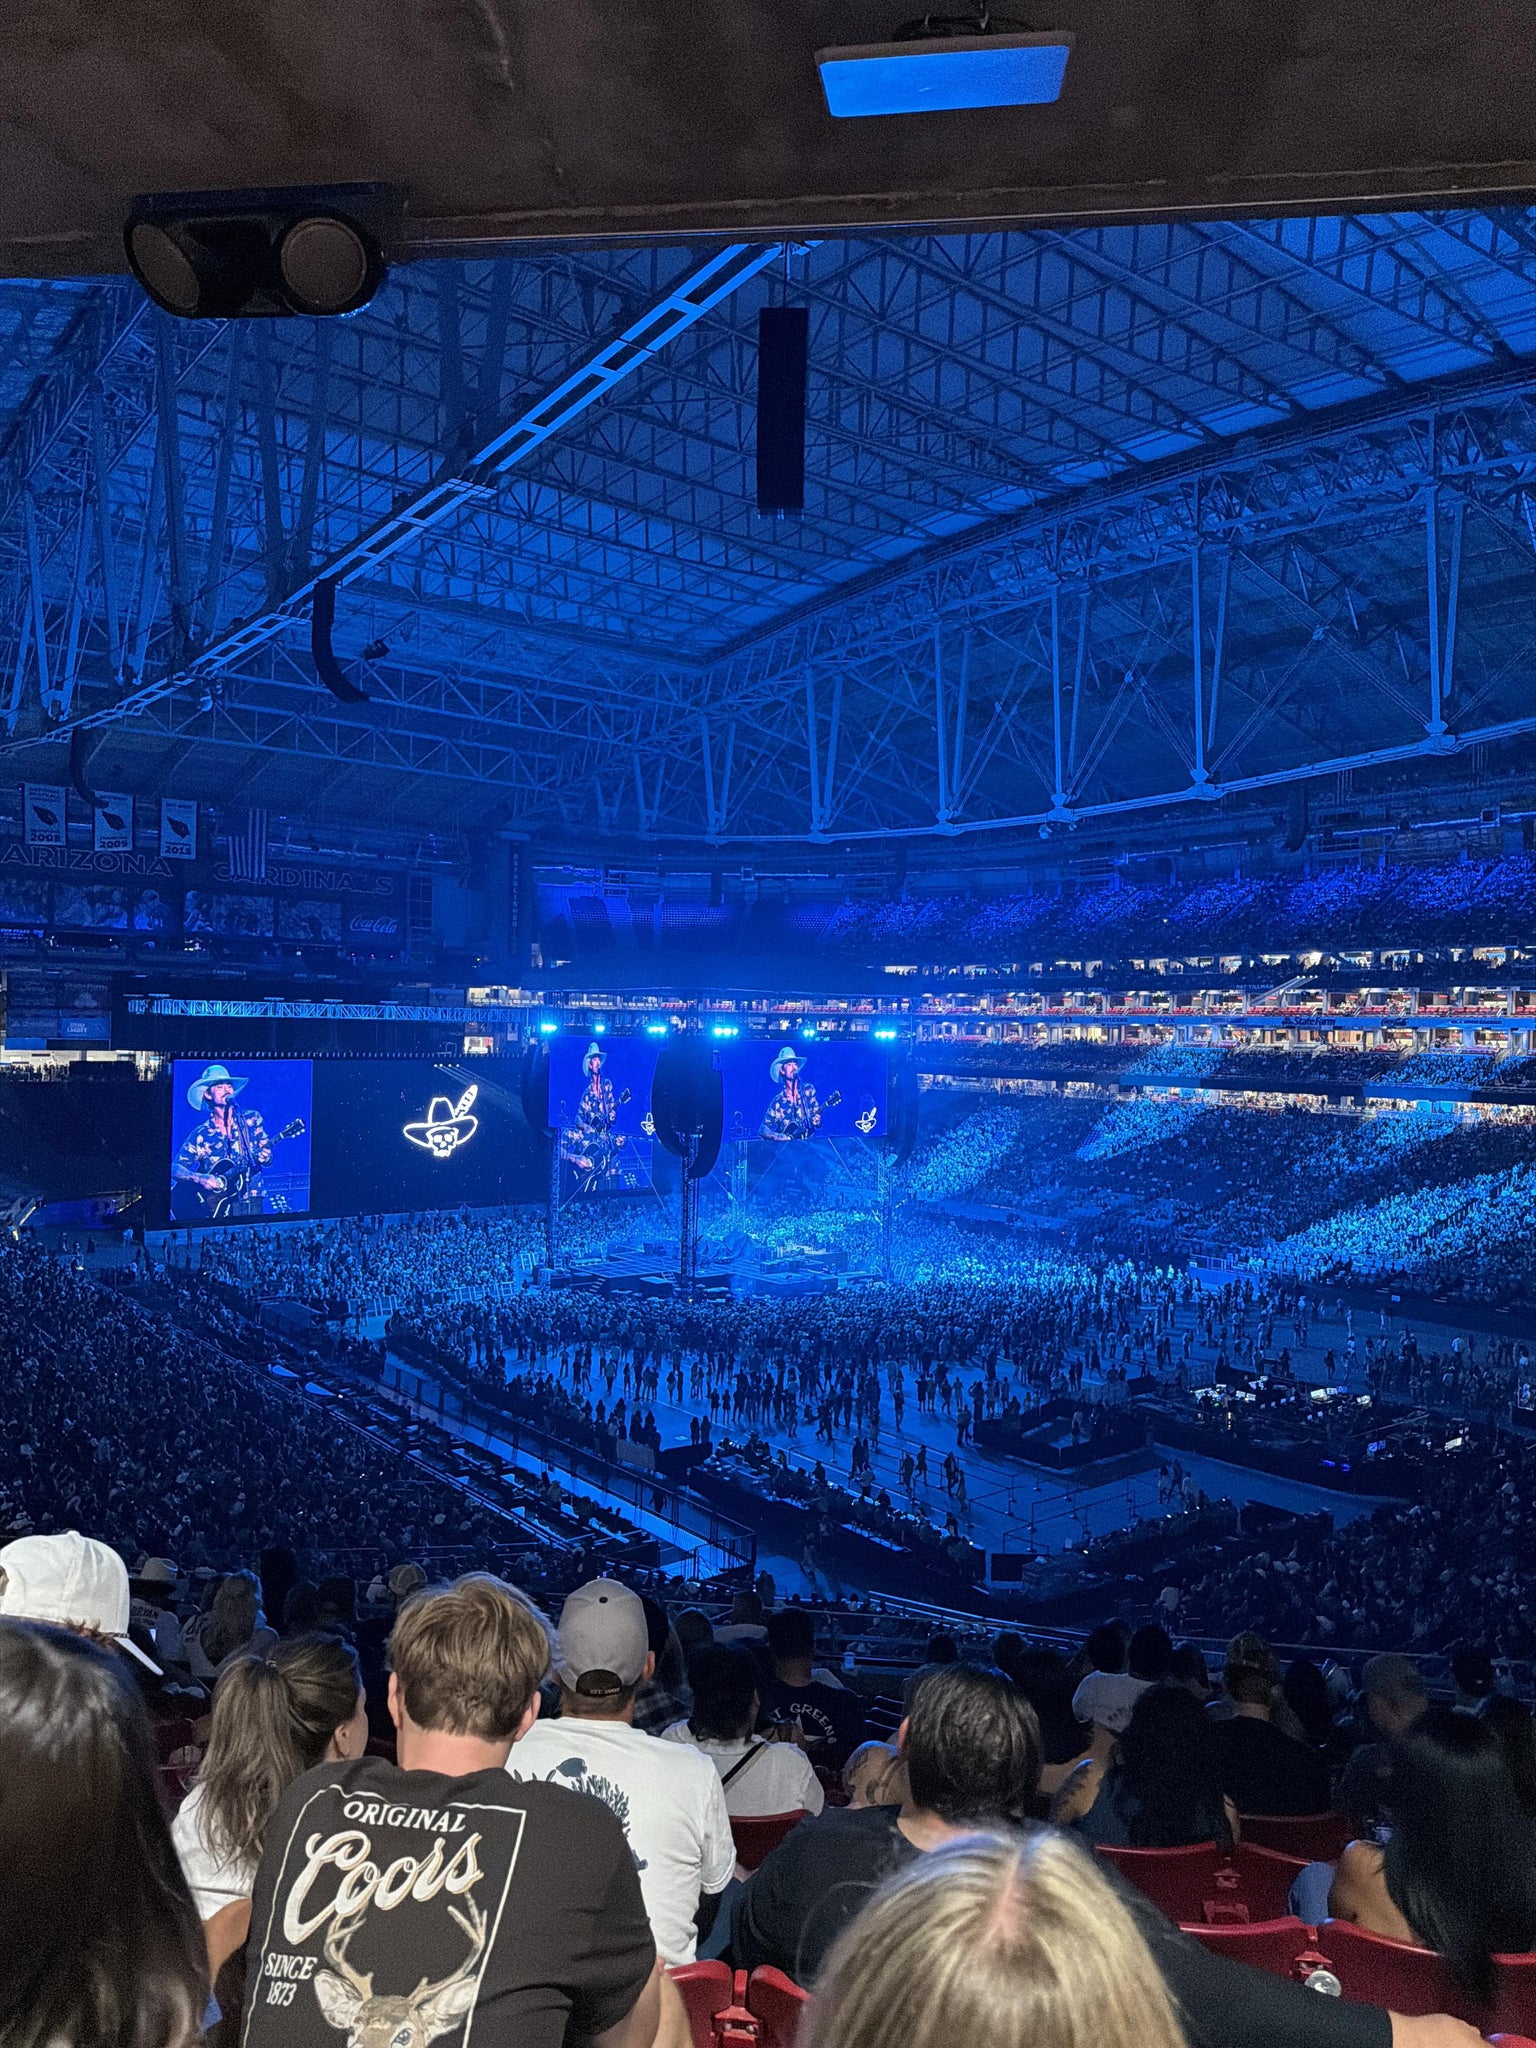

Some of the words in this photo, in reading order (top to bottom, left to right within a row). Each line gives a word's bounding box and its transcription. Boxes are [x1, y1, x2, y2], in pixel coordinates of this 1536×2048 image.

[0, 843, 174, 878] ARIZONA
[212, 861, 395, 896] CRDINAS
[342, 1800, 467, 1833] ORIGINAL
[282, 1829, 485, 1946] Coors
[264, 1951, 319, 1981] SINCE
[265, 1981, 298, 2008] 1873
